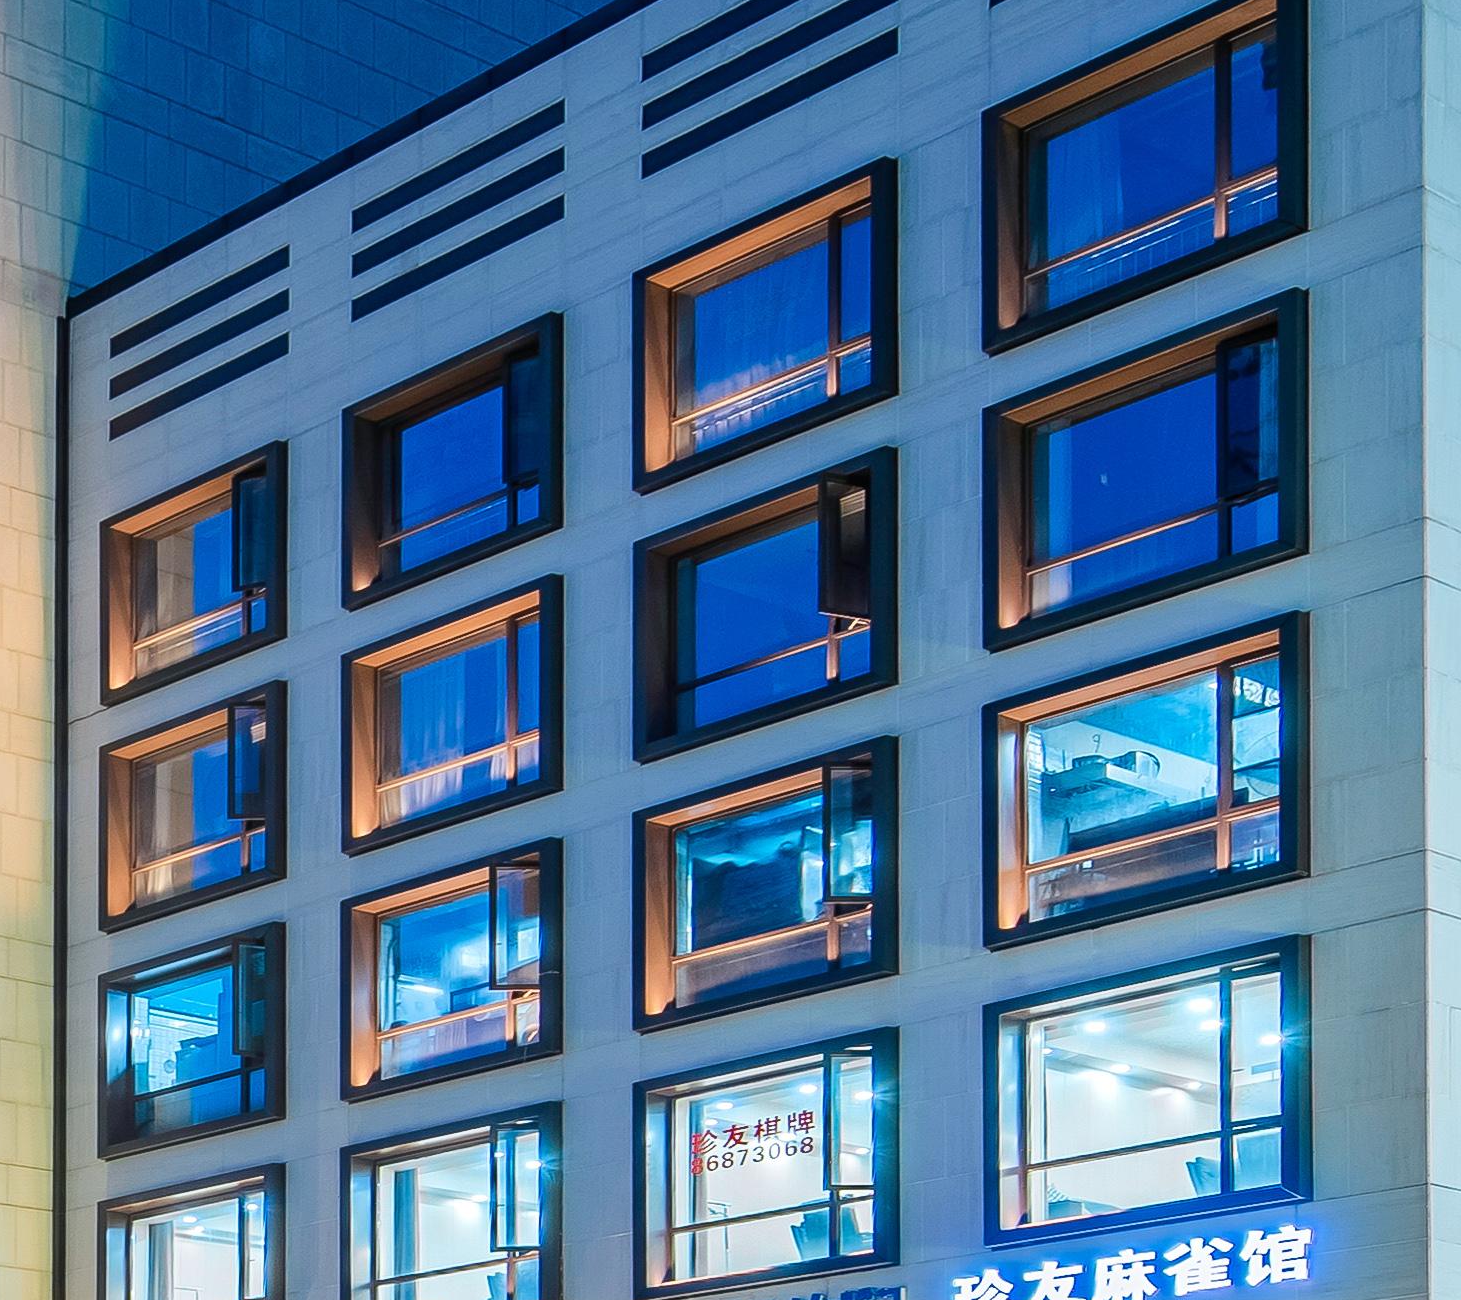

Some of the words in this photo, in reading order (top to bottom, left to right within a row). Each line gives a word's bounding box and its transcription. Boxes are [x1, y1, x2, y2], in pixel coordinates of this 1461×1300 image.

[691, 1110, 816, 1156] 珍友棋牌
[691, 1136, 815, 1175] 86873068
